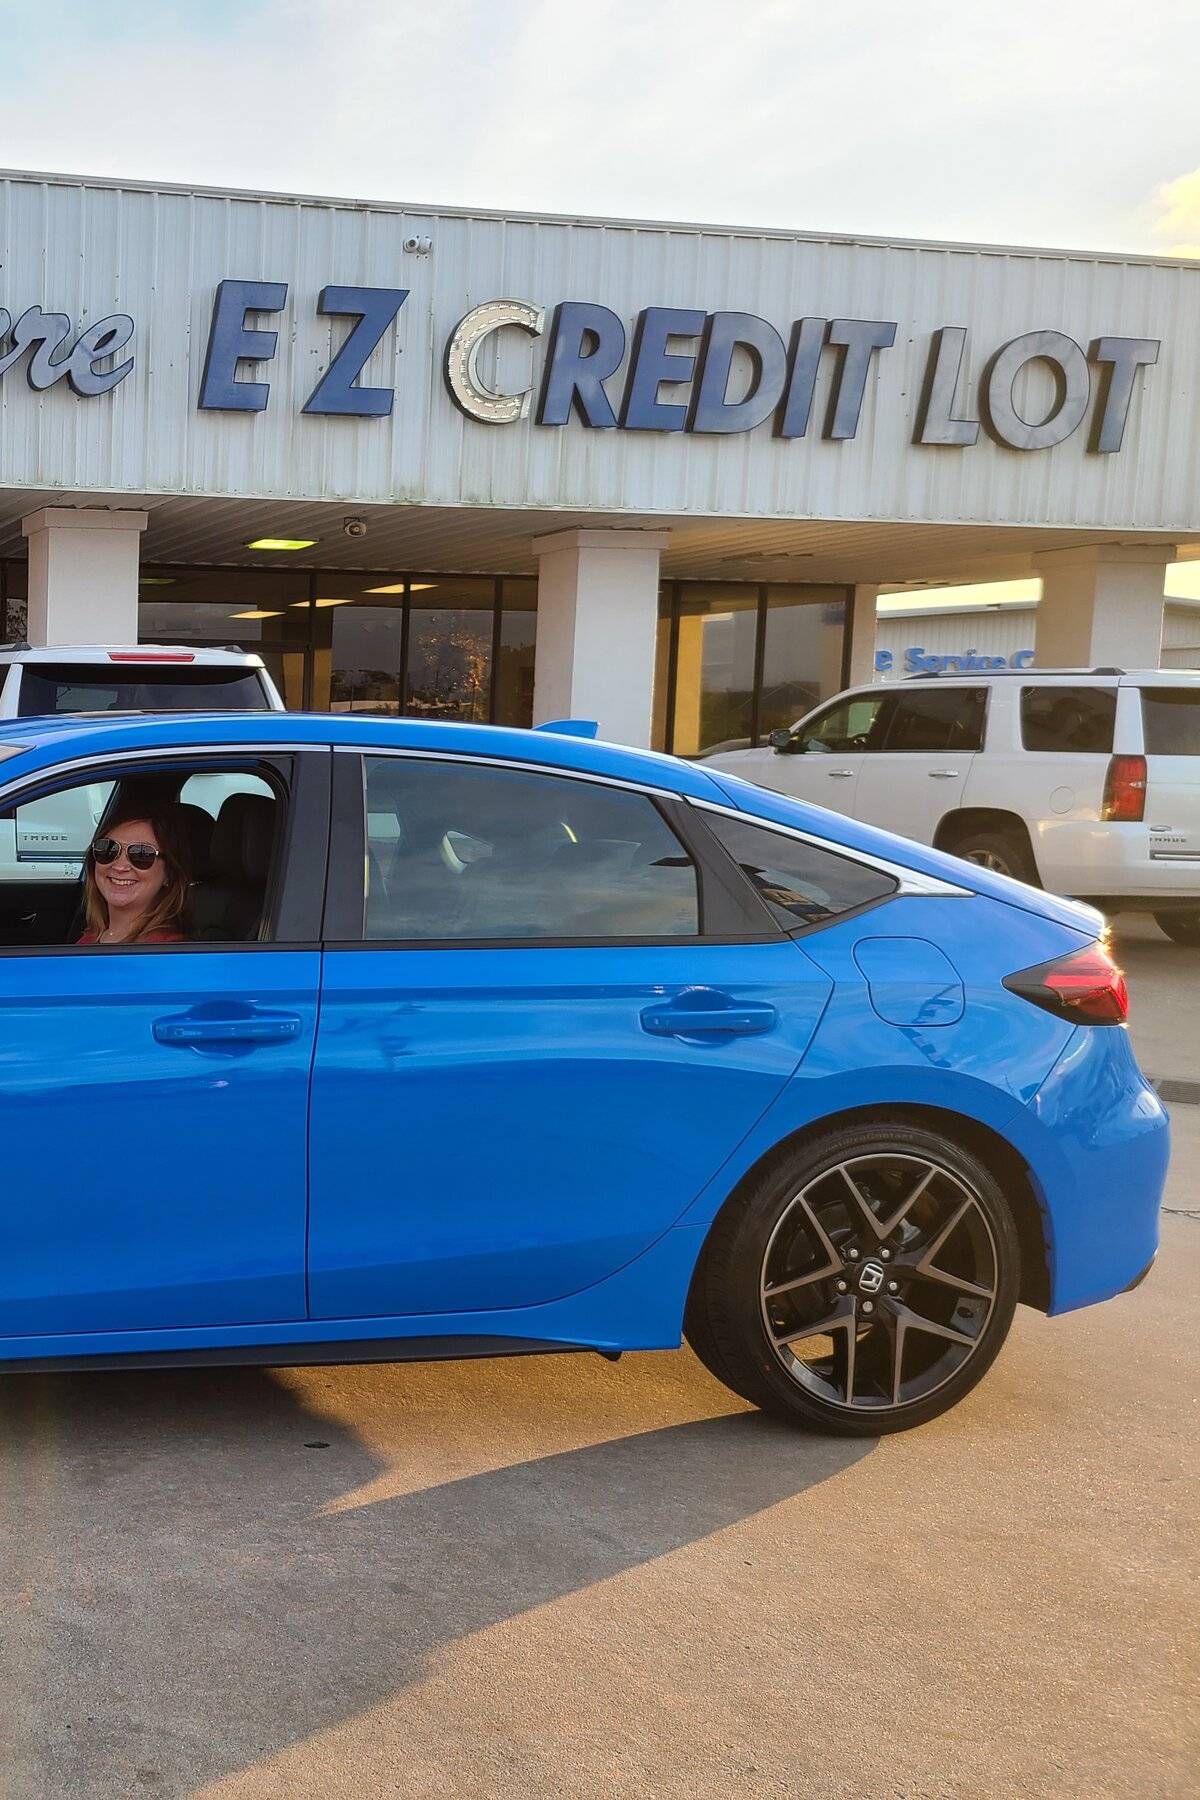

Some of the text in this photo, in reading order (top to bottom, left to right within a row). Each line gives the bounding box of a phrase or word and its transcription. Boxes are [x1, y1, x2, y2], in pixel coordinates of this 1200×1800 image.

[446, 297, 897, 440] CREDIT
[913, 326, 1160, 454] LOT
[904, 647, 1007, 673] Service
